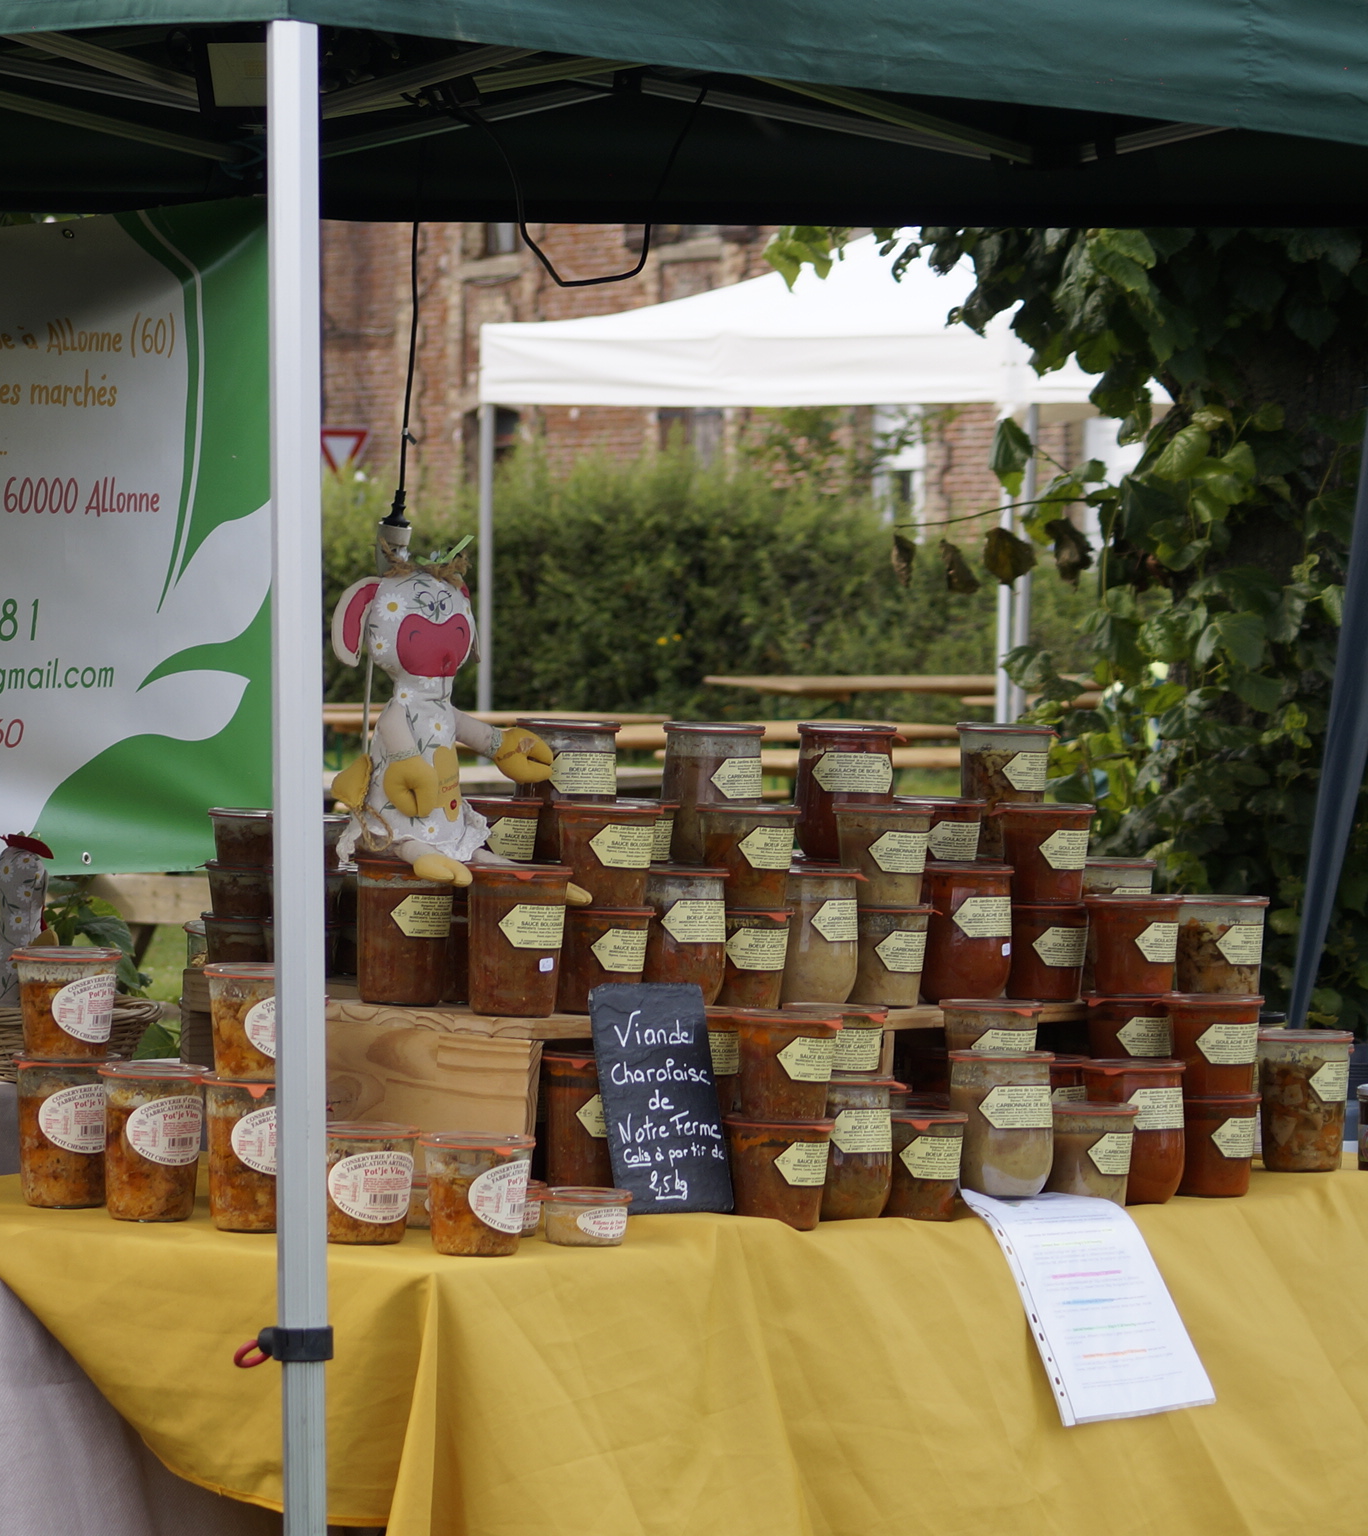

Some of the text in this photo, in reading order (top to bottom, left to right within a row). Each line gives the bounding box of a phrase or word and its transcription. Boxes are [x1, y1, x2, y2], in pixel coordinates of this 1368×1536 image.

[46, 317, 123, 355] Allonne
[131, 312, 176, 359] (60)
[30, 369, 118, 408] marchés
[3, 476, 79, 514] 60000
[84, 476, 160, 518] Allonne
[64, 1024, 80, 1035] PETIT
[613, 1010, 690, 1048] Viande
[611, 1057, 712, 1086] Charolaise
[52, 1087, 92, 1103] CONSERVERIE
[57, 1093, 95, 1107] FABRICATION
[648, 1089, 675, 1111] de
[74, 1099, 95, 1109] Pot'je
[141, 1098, 181, 1114] CONSERVERIE
[146, 1105, 184, 1118] FABRICATION
[163, 1111, 184, 1121] Pot'je
[618, 1110, 722, 1145] Notre Ferme
[51, 1134, 67, 1145] PETIT
[139, 1147, 176, 1163] PETIT CHEMIN
[342, 1154, 385, 1168] CONSERVERIE
[623, 1142, 725, 1167] Colis à partir de
[347, 1160, 387, 1173] FABRICATION
[364, 1167, 388, 1176] Pot'je
[339, 1201, 378, 1220] PETIT CHEMIN
[481, 1213, 496, 1224] PETIT
